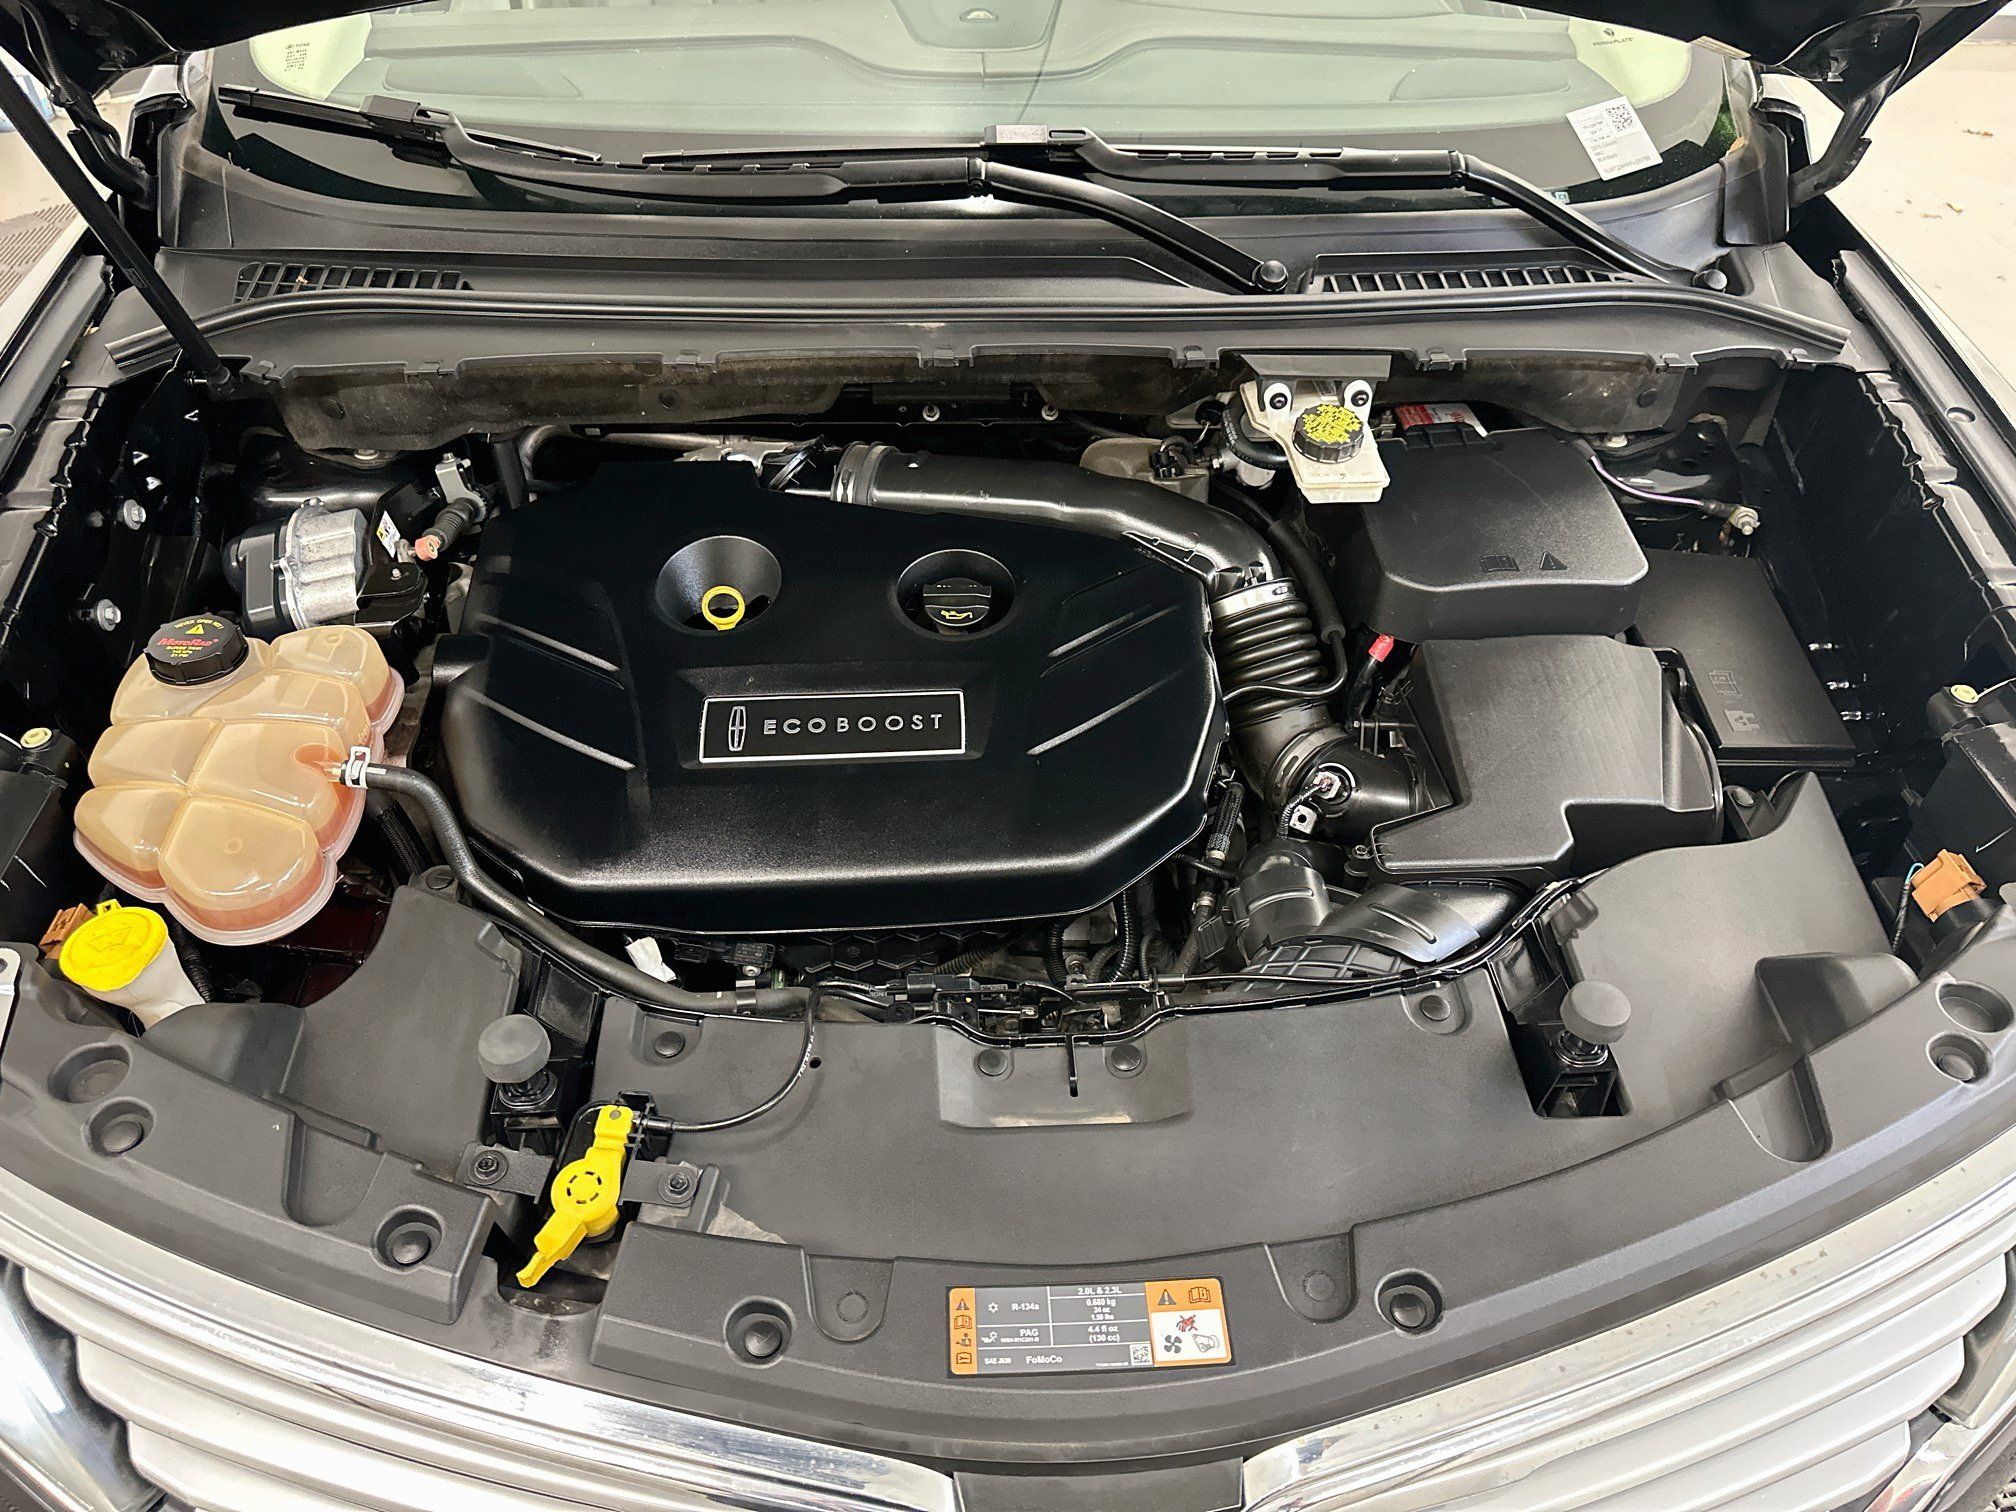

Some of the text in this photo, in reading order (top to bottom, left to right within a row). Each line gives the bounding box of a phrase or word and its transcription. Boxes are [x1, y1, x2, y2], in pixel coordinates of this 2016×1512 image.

[174, 620, 195, 629] NEVER
[763, 713, 942, 735] ECOBOOST
[1077, 1286, 1122, 1295] 2.0L & 2.3L
[1011, 1302, 1040, 1311] R-134a
[1106, 1298, 1116, 1307] kg
[1019, 1328, 1039, 1337] PAG
[1100, 1324, 1107, 1332] fl
[1088, 1333, 1120, 1343] (130 cc)
[984, 1357, 998, 1365] SAE
[1025, 1354, 1063, 1364] FoMoCo
